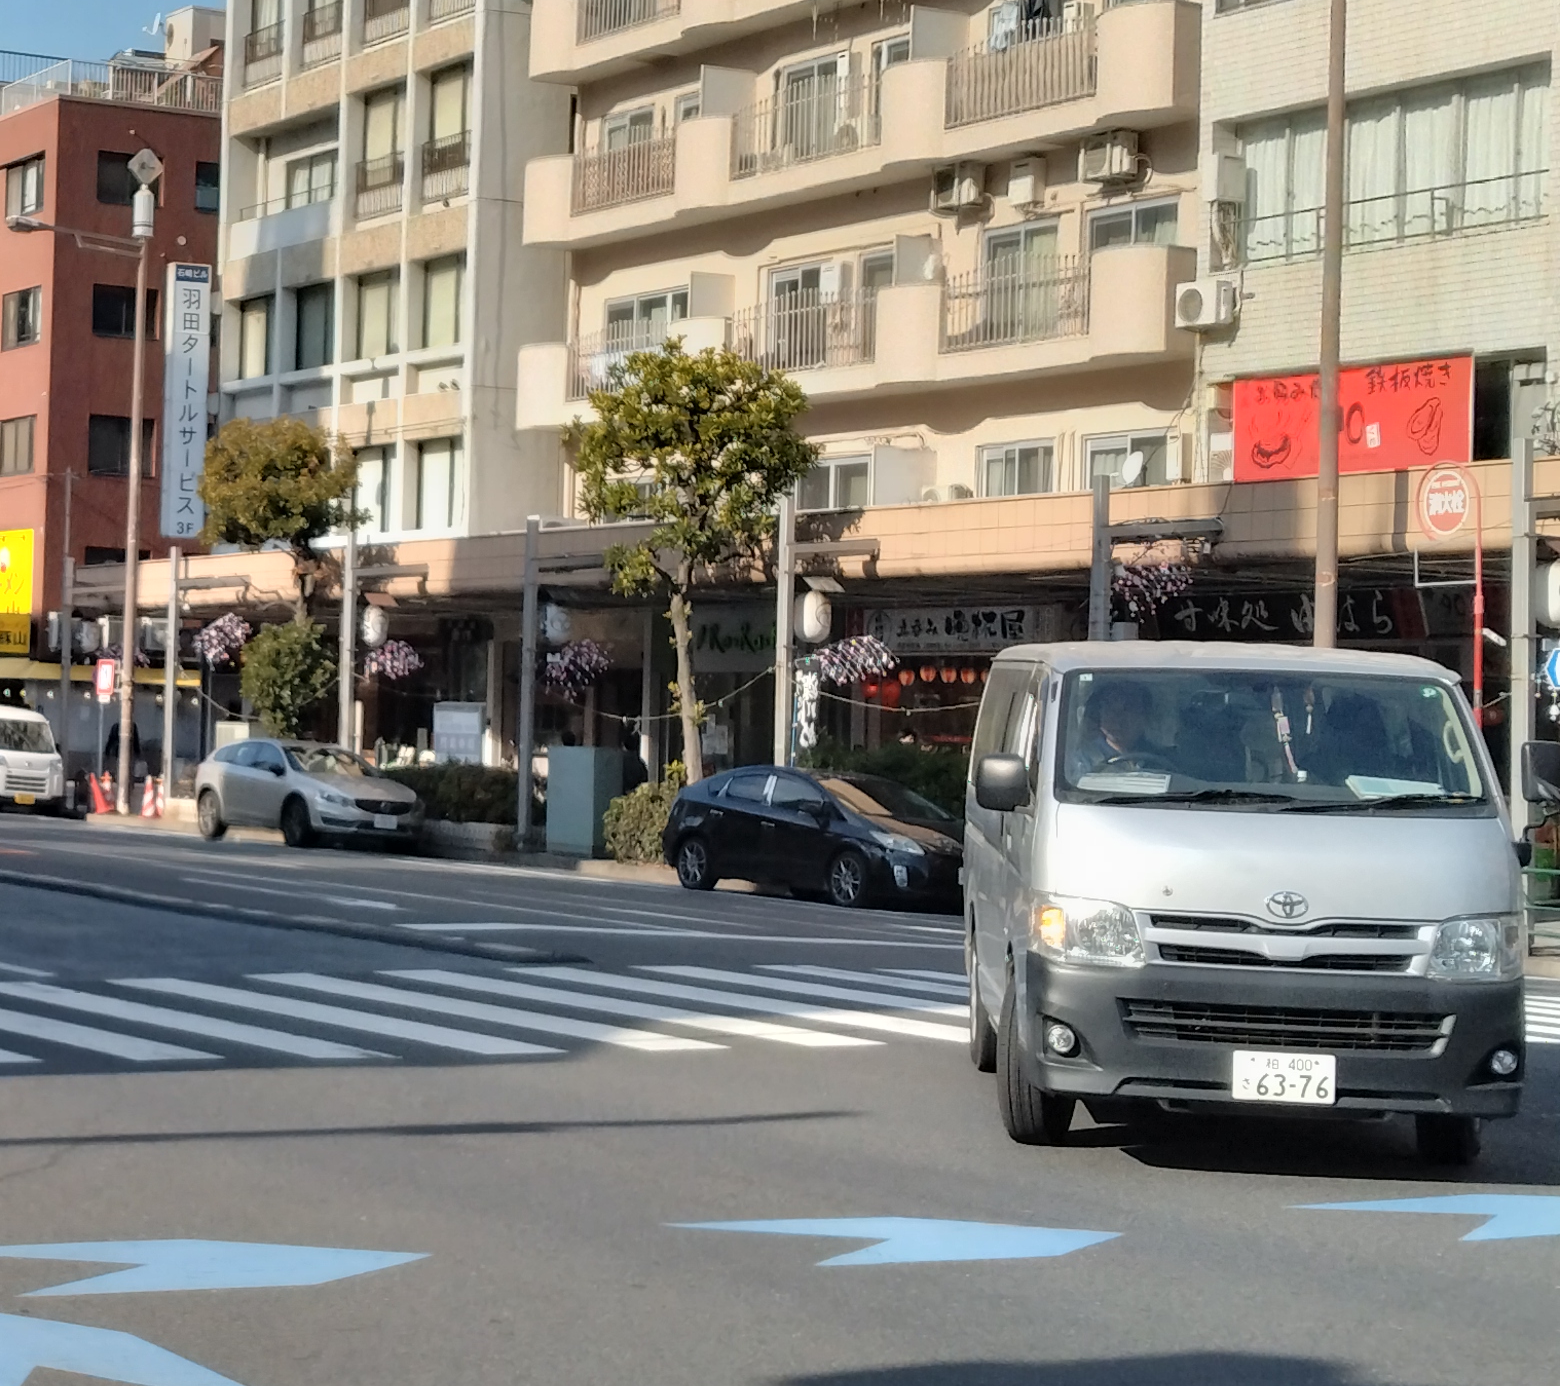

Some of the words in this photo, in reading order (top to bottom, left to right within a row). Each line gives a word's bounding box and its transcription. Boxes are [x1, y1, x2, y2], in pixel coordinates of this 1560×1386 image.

[1366, 362, 1452, 395] 鉄板焼き
[178, 287, 201, 515] 羽田タートルサービス
[1429, 489, 1465, 516] 消火栓
[177, 521, 194, 535] 3F
[1174, 597, 1279, 632] 甘味処
[1288, 1059, 1313, 1072] 400
[1256, 1073, 1329, 1099] 63-76
